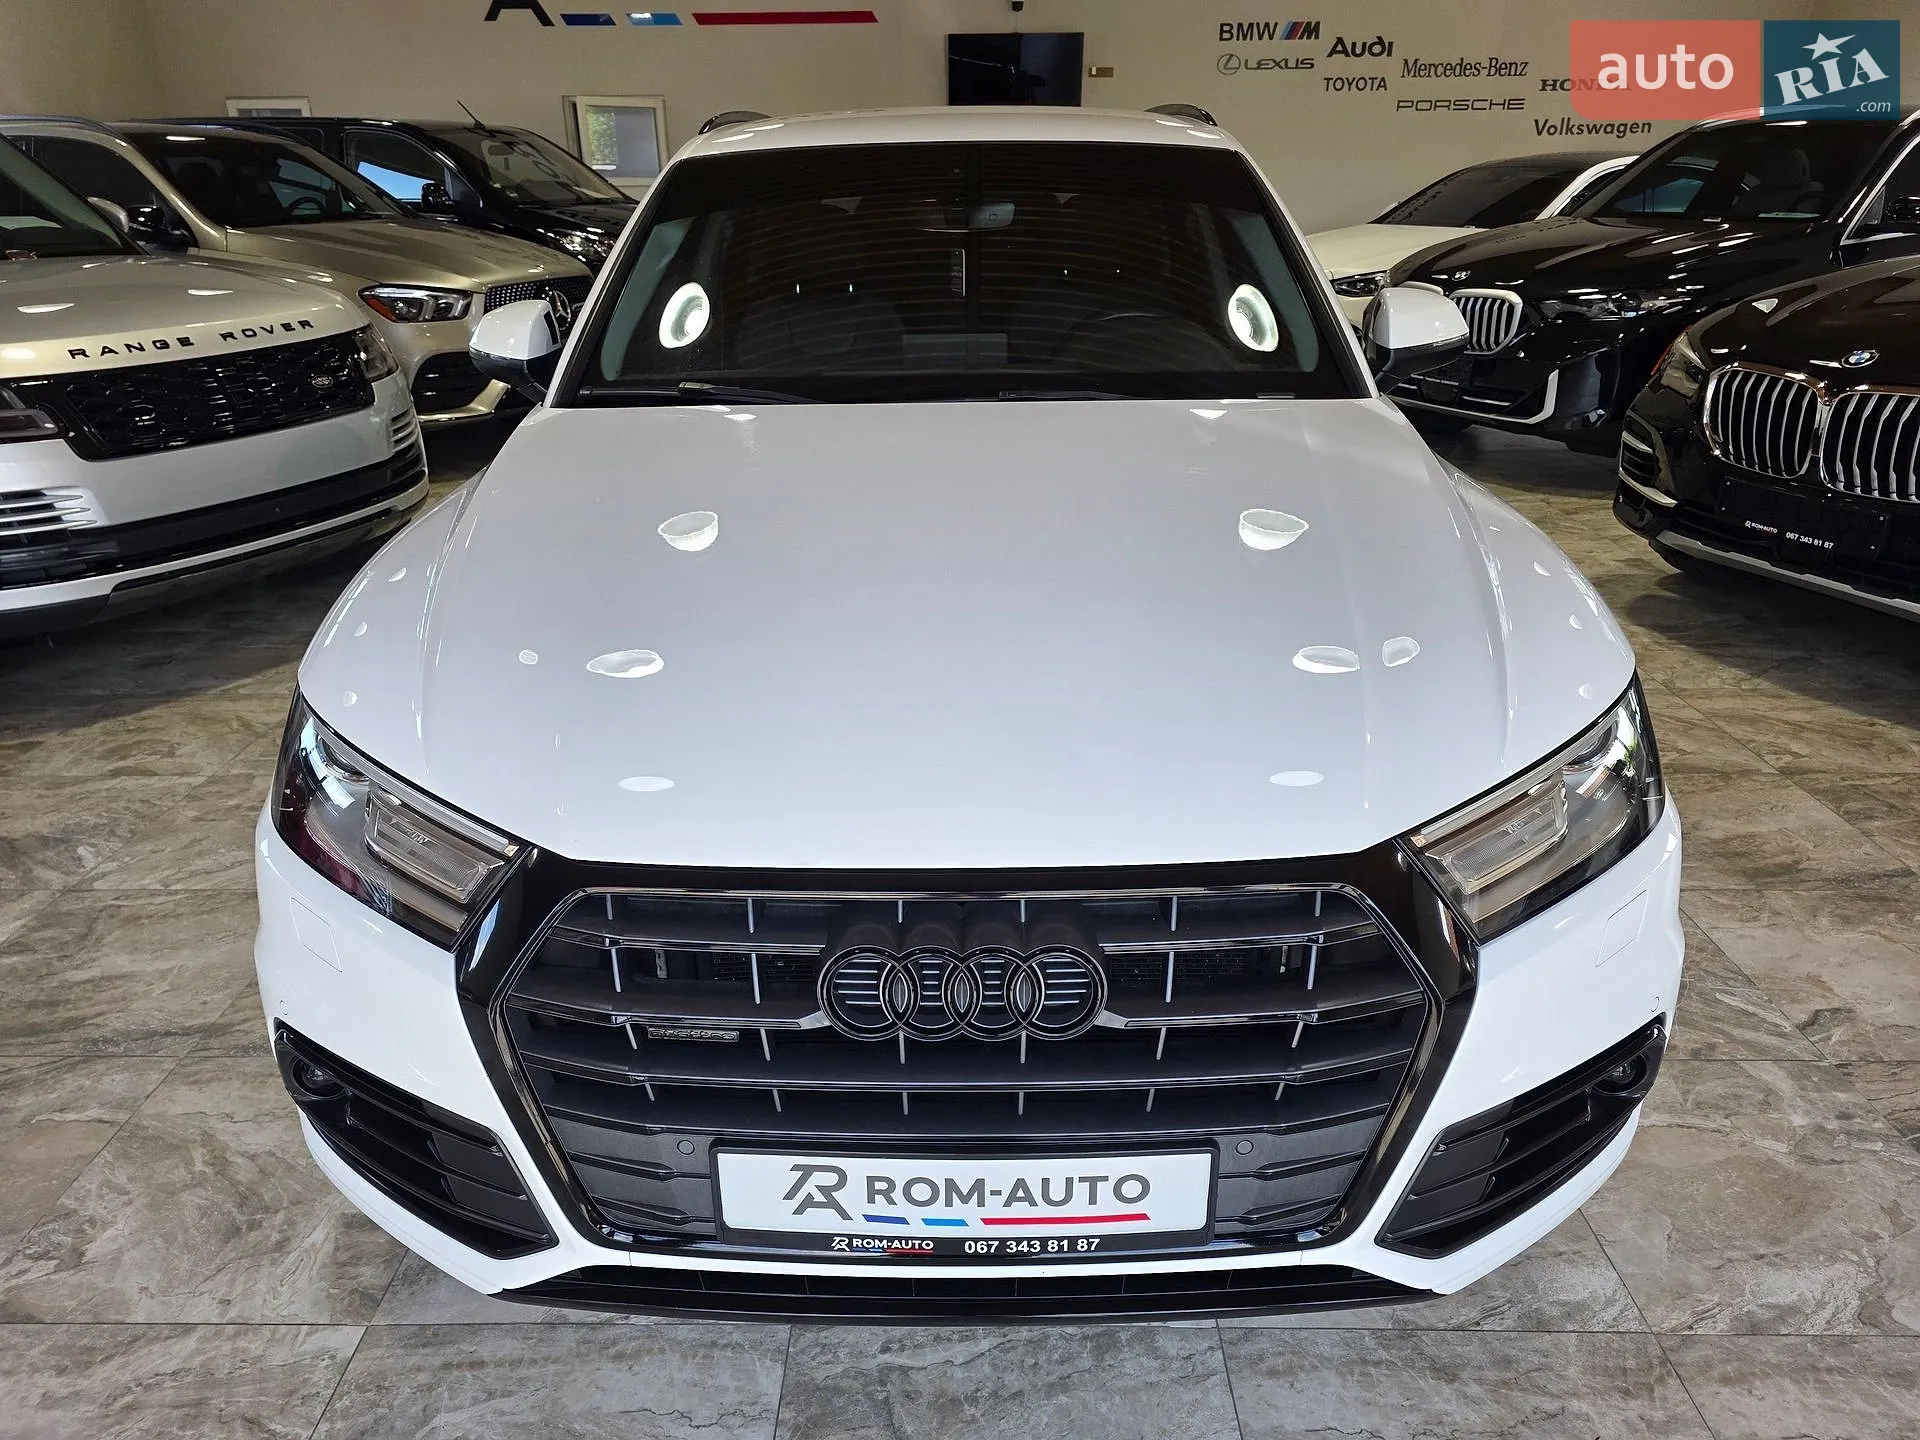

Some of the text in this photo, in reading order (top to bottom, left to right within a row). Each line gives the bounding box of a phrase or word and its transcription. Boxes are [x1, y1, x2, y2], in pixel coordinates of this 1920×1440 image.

[1218, 22, 1279, 41] BMW
[1326, 35, 1394, 58] Audi
[1244, 58, 1315, 71] LEXUS
[1400, 57, 1529, 79] Mercedes-Benz
[1323, 76, 1388, 92] TOYOTA
[1396, 98, 1527, 113] PORSCHE
[1533, 117, 1653, 139] Volkswagen
[66, 318, 315, 360] RANGE ROVER
[1823, 541, 1834, 550] 87
[866, 1173, 1151, 1208] ROM-AUTO
[851, 1238, 934, 1249] ROM-AUTO
[964, 1238, 1101, 1254] 067 343 81 87
